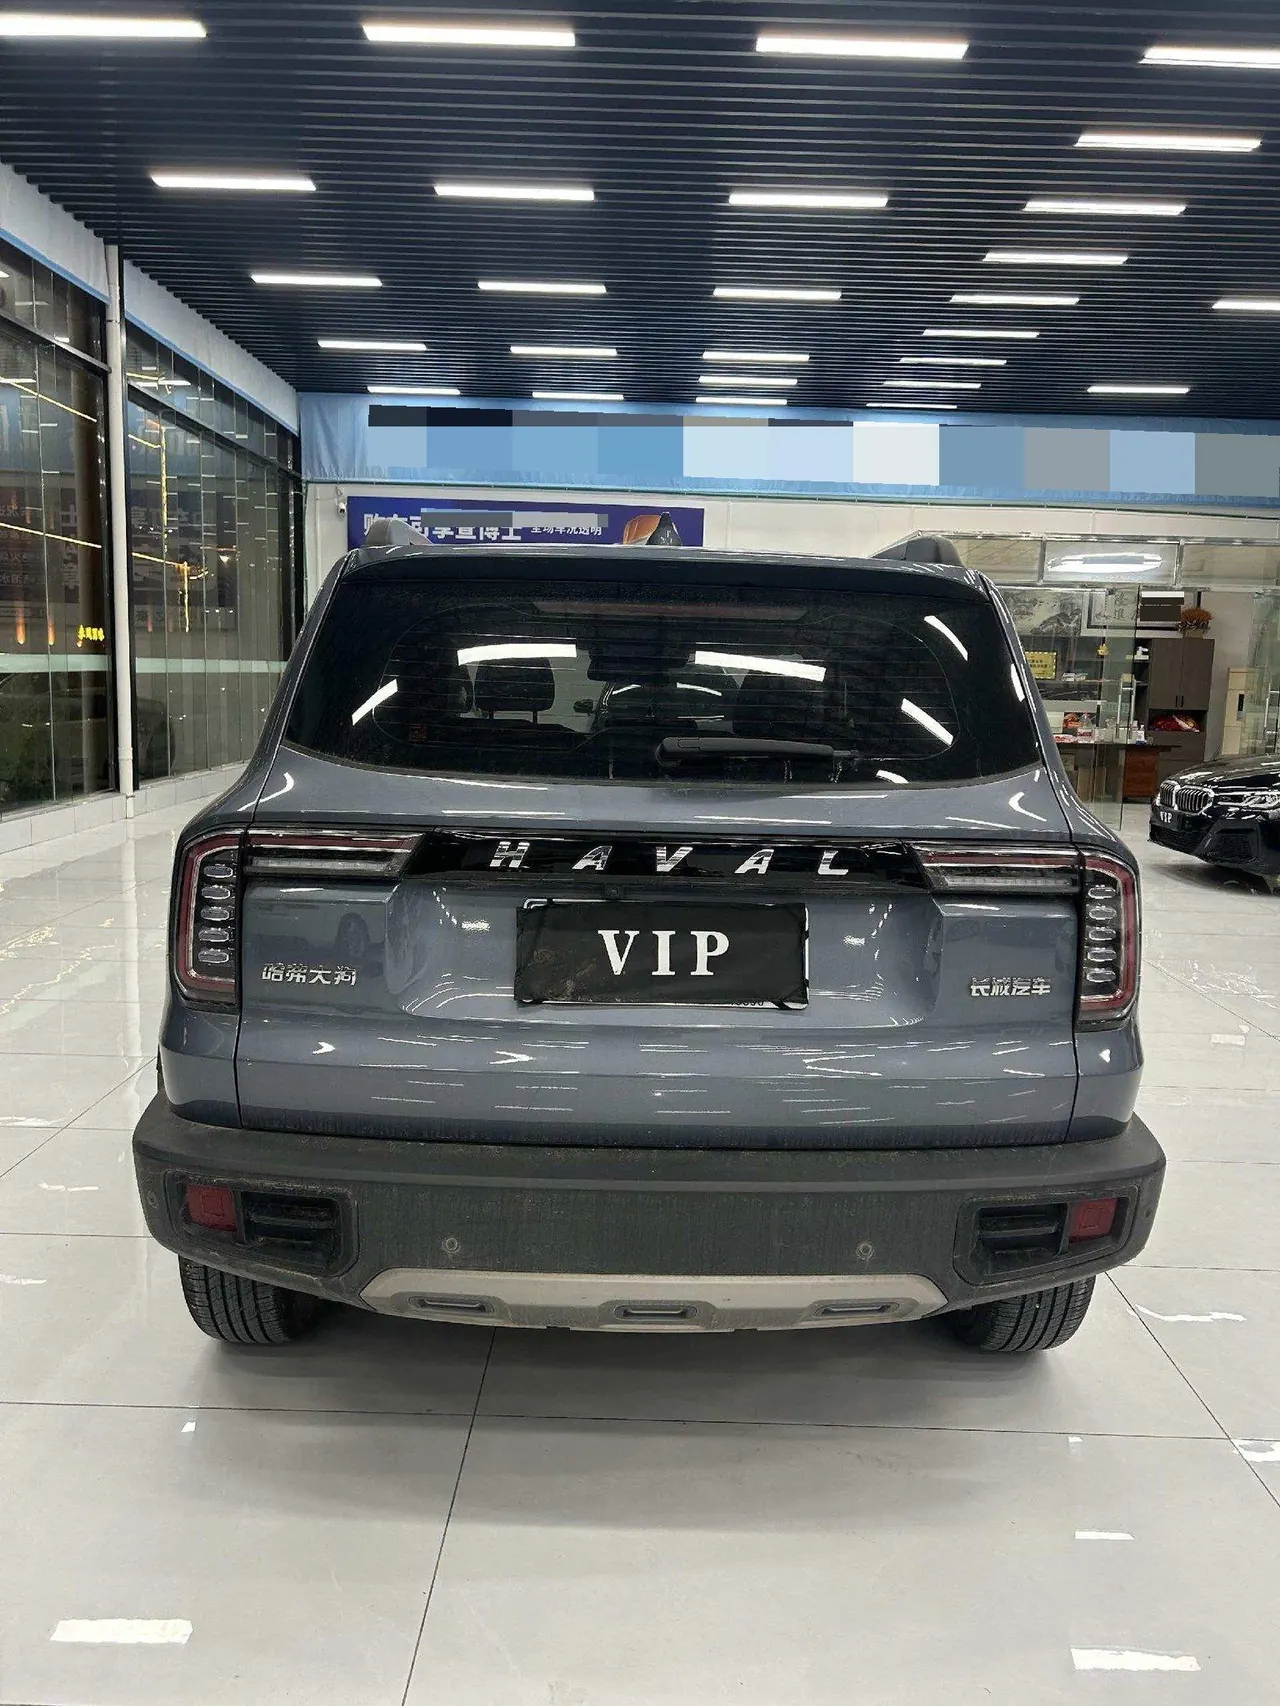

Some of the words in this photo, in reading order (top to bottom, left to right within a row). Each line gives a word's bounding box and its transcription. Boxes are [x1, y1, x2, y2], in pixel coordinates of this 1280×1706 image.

[489, 842, 849, 875] HAVAL
[597, 930, 730, 976] VIP
[262, 963, 357, 985] 哈弗大狗
[970, 977, 1051, 996] 长城汽车
